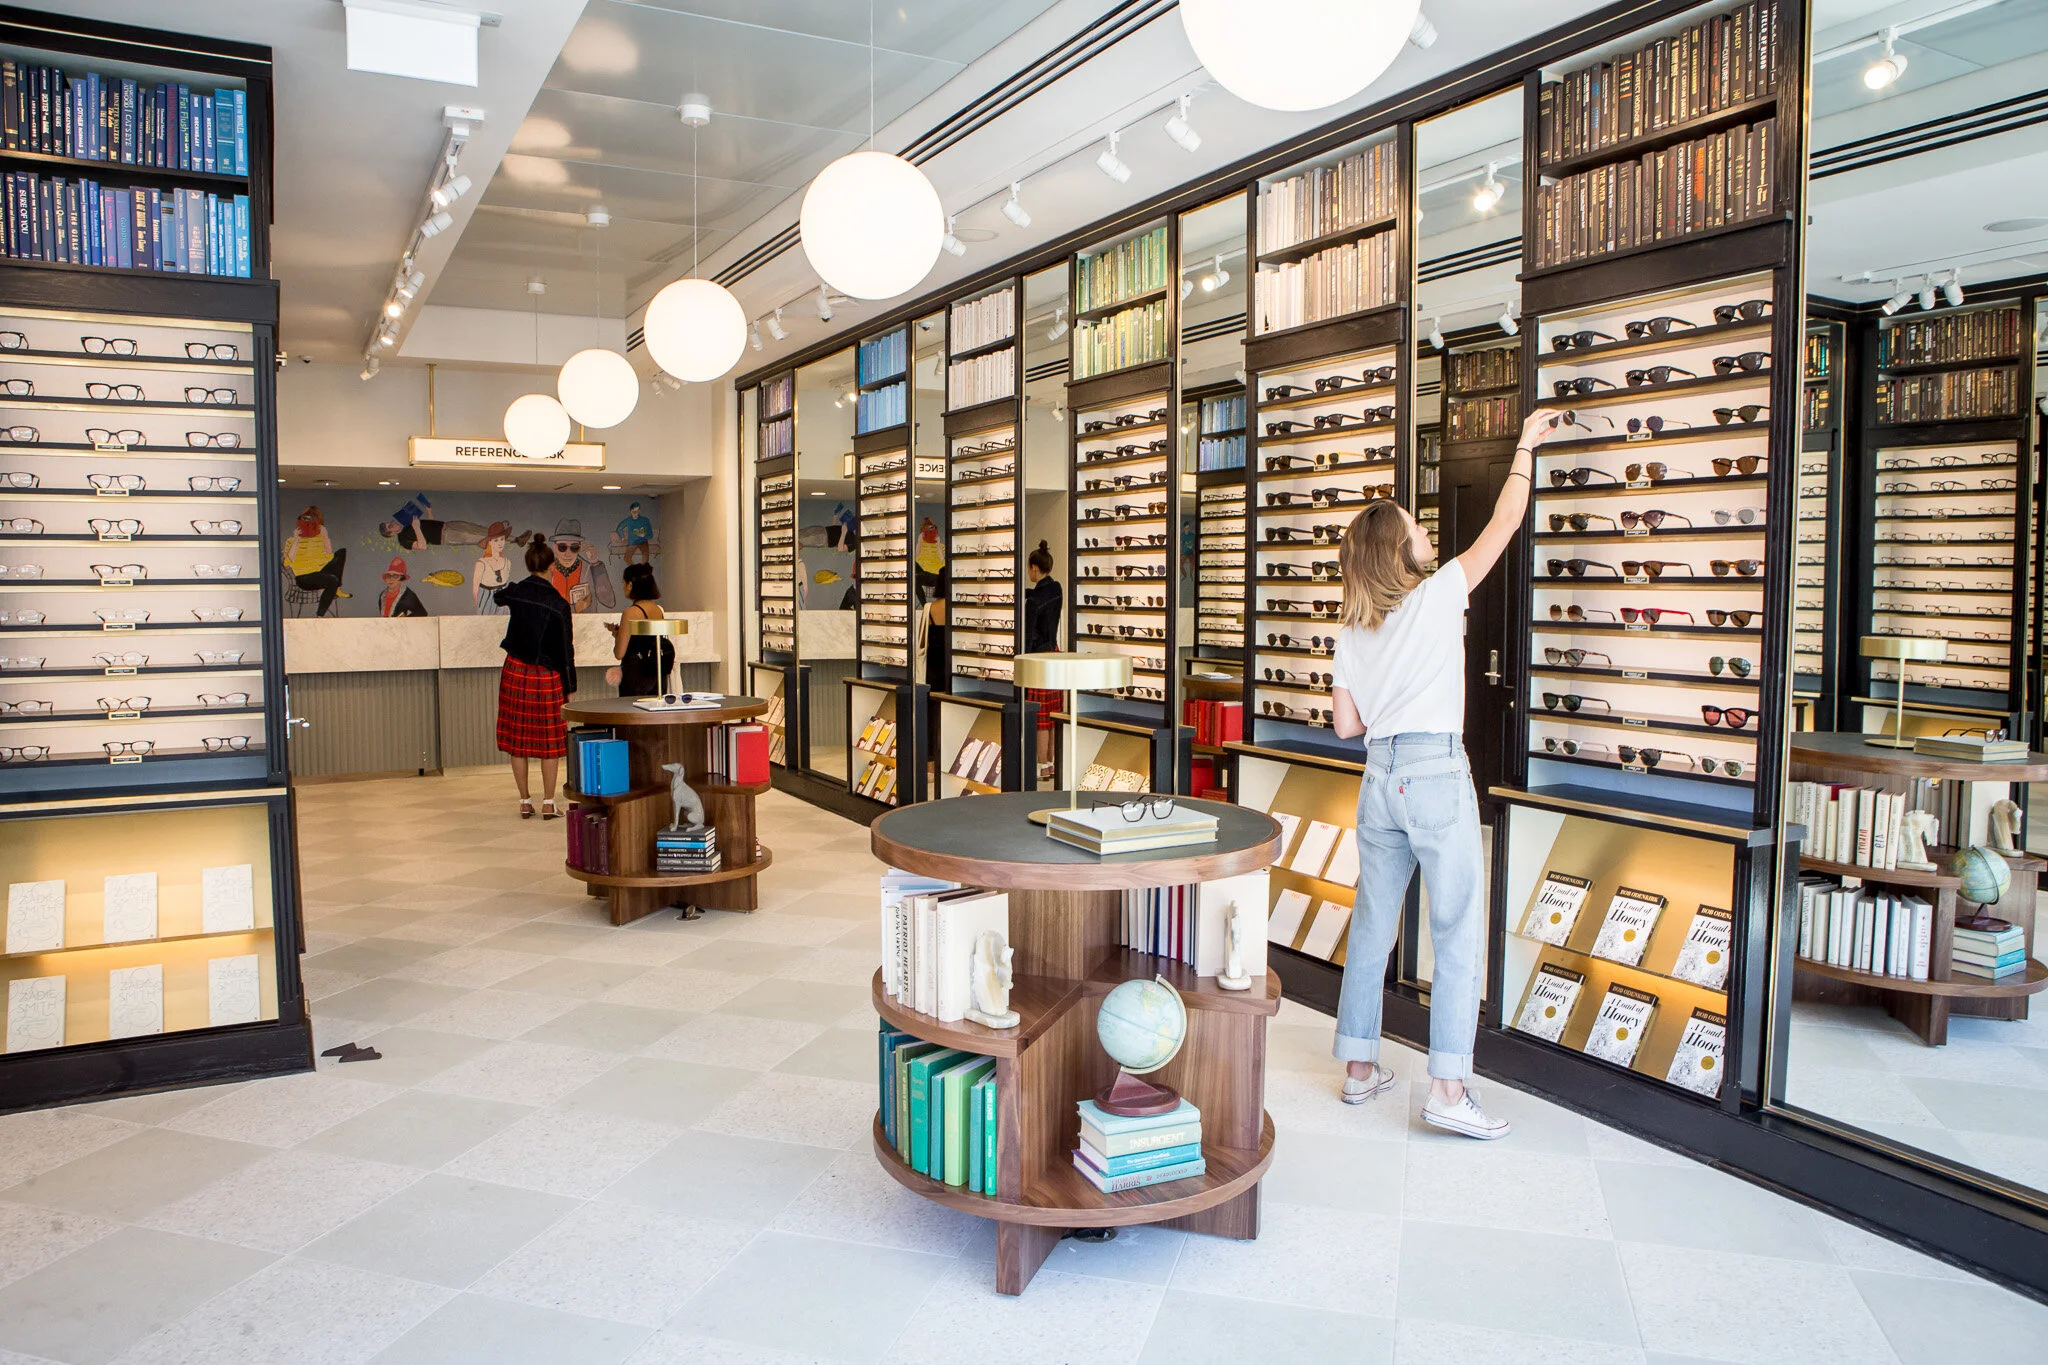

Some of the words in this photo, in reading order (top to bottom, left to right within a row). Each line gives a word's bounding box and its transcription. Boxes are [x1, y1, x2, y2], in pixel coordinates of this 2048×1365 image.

[1760, 10, 1768, 34] FIELD
[1734, 28, 1742, 50] QUEST
[1760, 35, 1768, 45] OF
[1760, 46, 1768, 70] BLOOD
[41, 93, 49, 112] DEXTER
[180, 96, 189, 109] Fat
[180, 111, 189, 132] Flush
[19, 189, 27, 208] SURE
[20, 208, 28, 219] OF
[21, 220, 29, 234] YOU
[71, 228, 79, 251] GIRLS
[455, 446, 528, 458] REFERENC
[1540, 892, 1576, 912] Hooey
[1610, 909, 1650, 930] Hooey
[1713, 910, 1732, 920] ODEN
[1534, 984, 1569, 1006] Hooey
[1603, 1006, 1642, 1030] Hooey
[1694, 1010, 1708, 1018] BOB
[1708, 1014, 1726, 1025] ODEN
[1130, 1132, 1186, 1149] INSURGENT
[1112, 1181, 1140, 1191] HARRIS
[1156, 1168, 1188, 1180] DEADLOCKED
